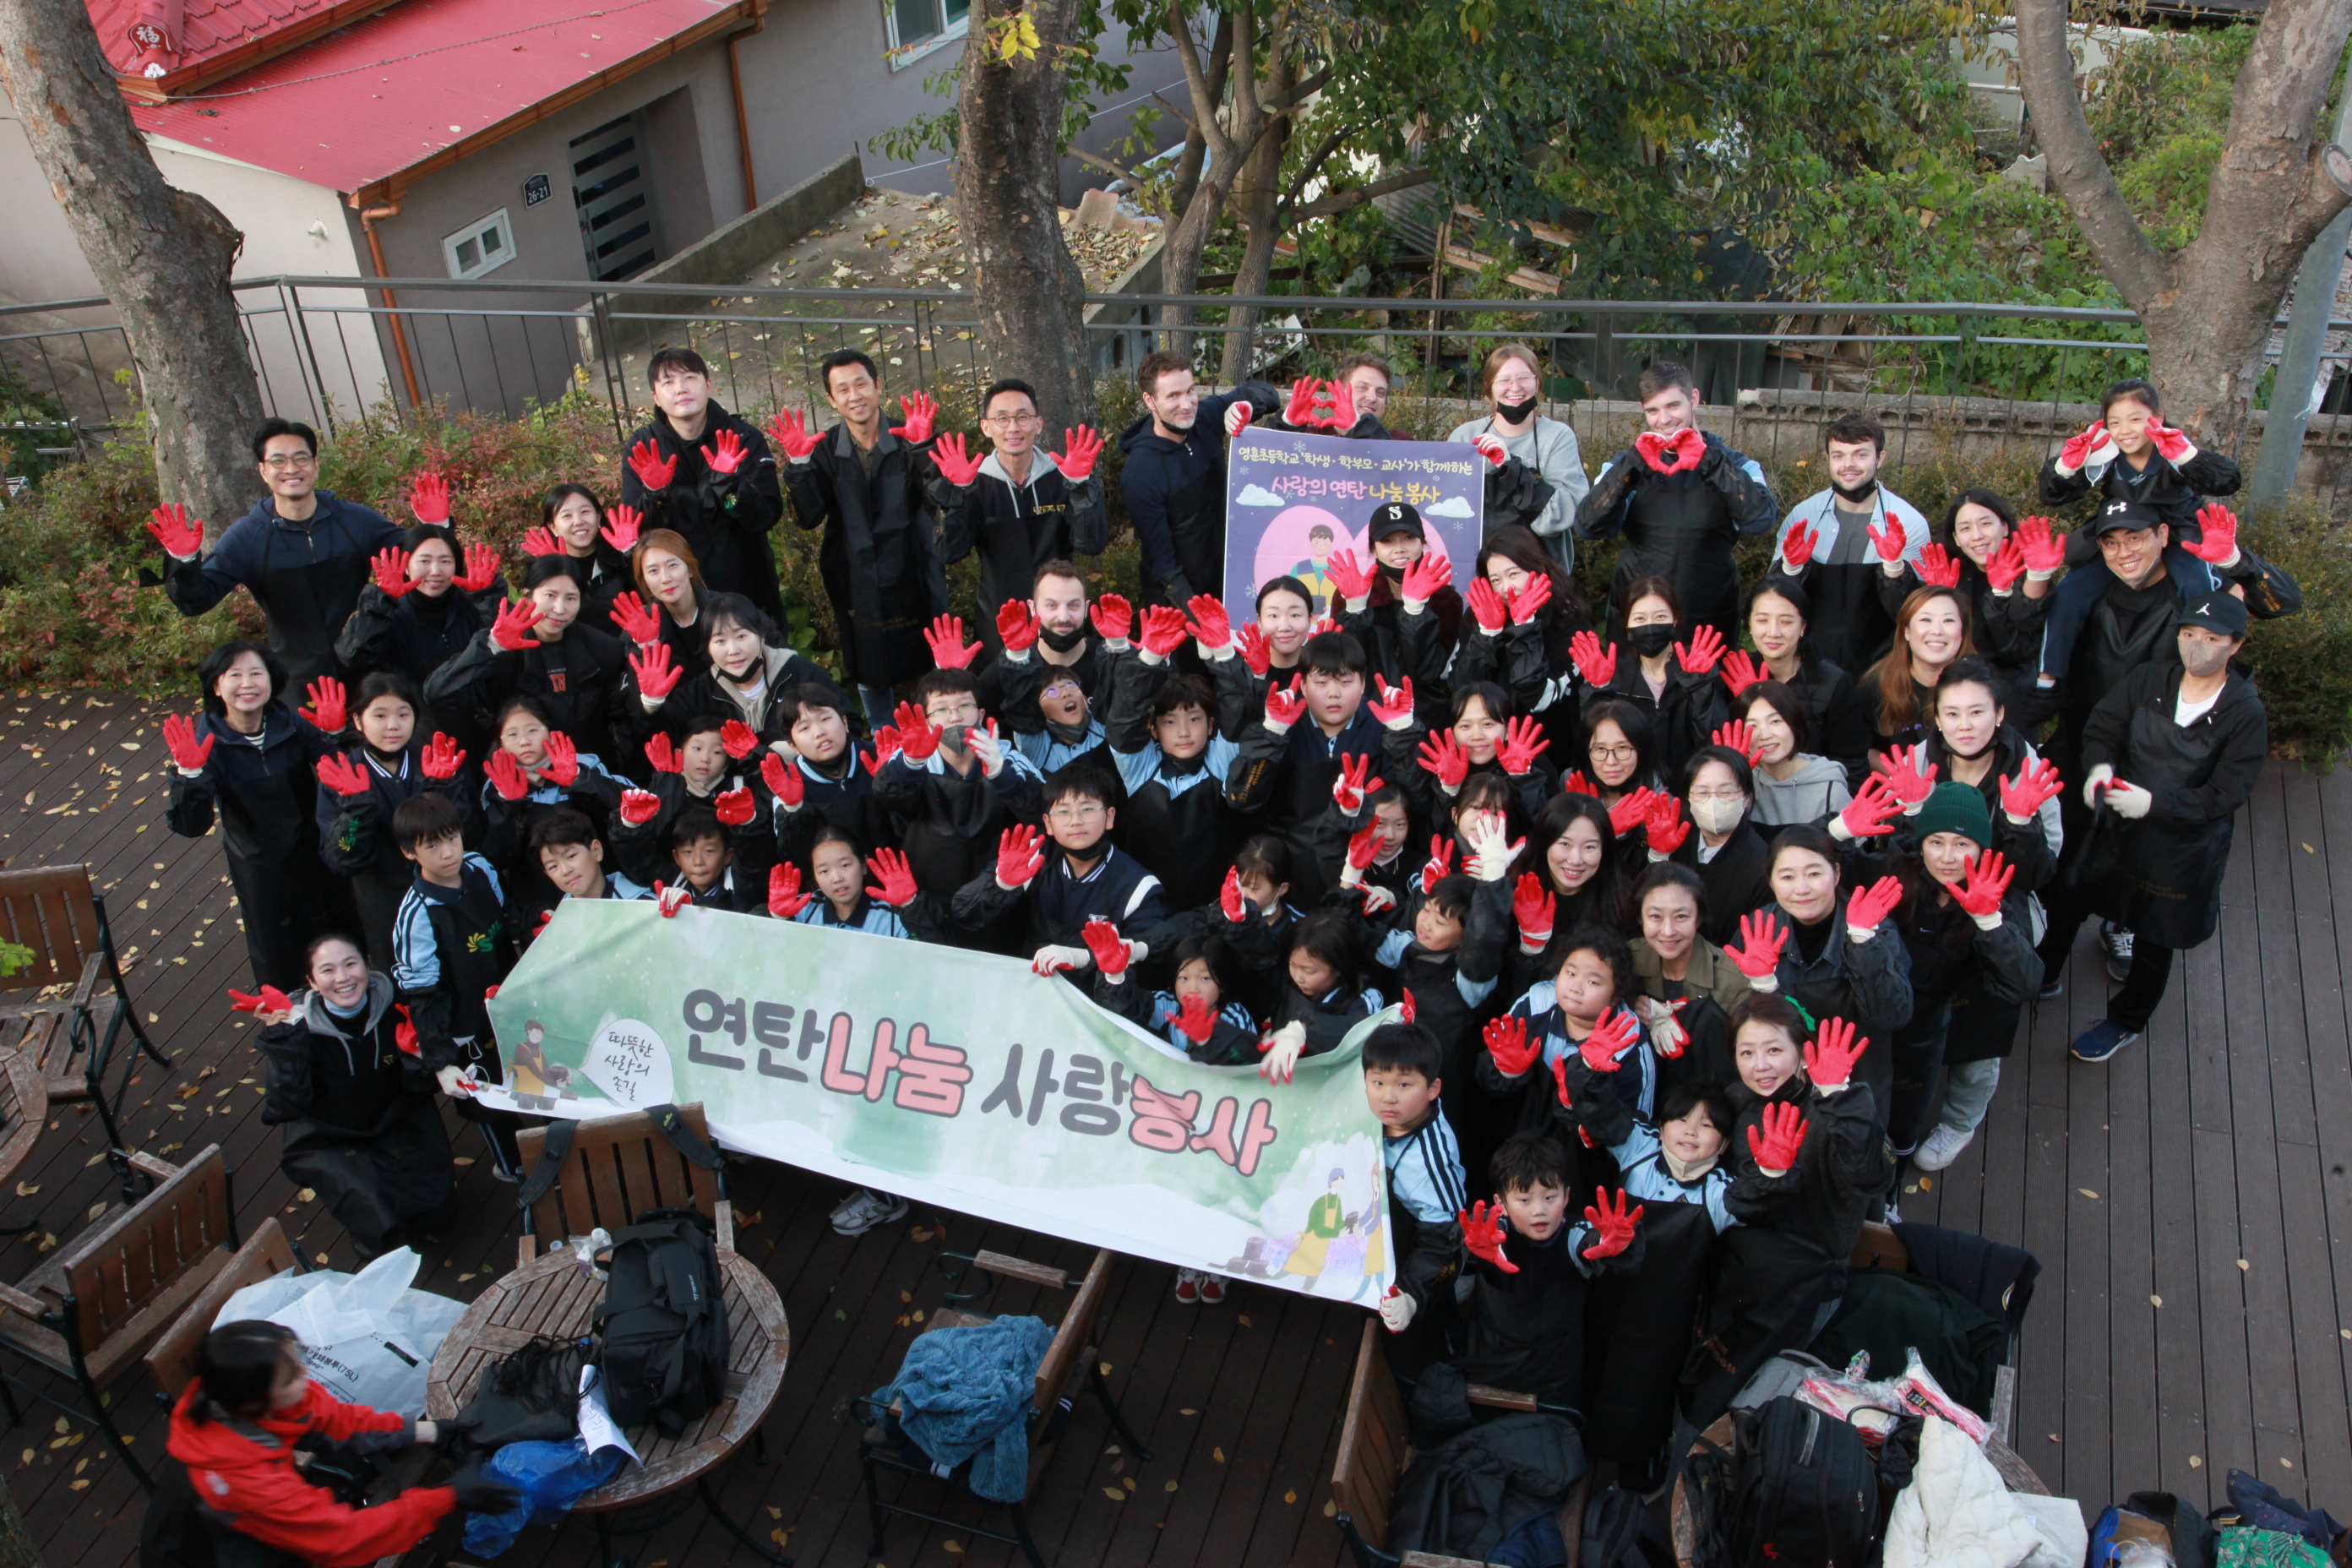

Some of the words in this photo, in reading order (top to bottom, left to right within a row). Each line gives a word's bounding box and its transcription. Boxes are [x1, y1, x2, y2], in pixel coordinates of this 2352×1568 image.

[136, 25, 161, 44] 福
[527, 185, 549, 204] 26-21
[1238, 446, 1300, 466] 영훈초등학교
[1271, 475, 1328, 498] 사랑의
[1329, 479, 1369, 501] 연탄
[1369, 481, 1404, 504] 나눔
[1404, 482, 1441, 506] 봉사
[1388, 505, 1403, 520] S
[608, 1032, 655, 1062] 따뜻한
[604, 1054, 651, 1077] 사랑의
[612, 1075, 637, 1102] 손길
